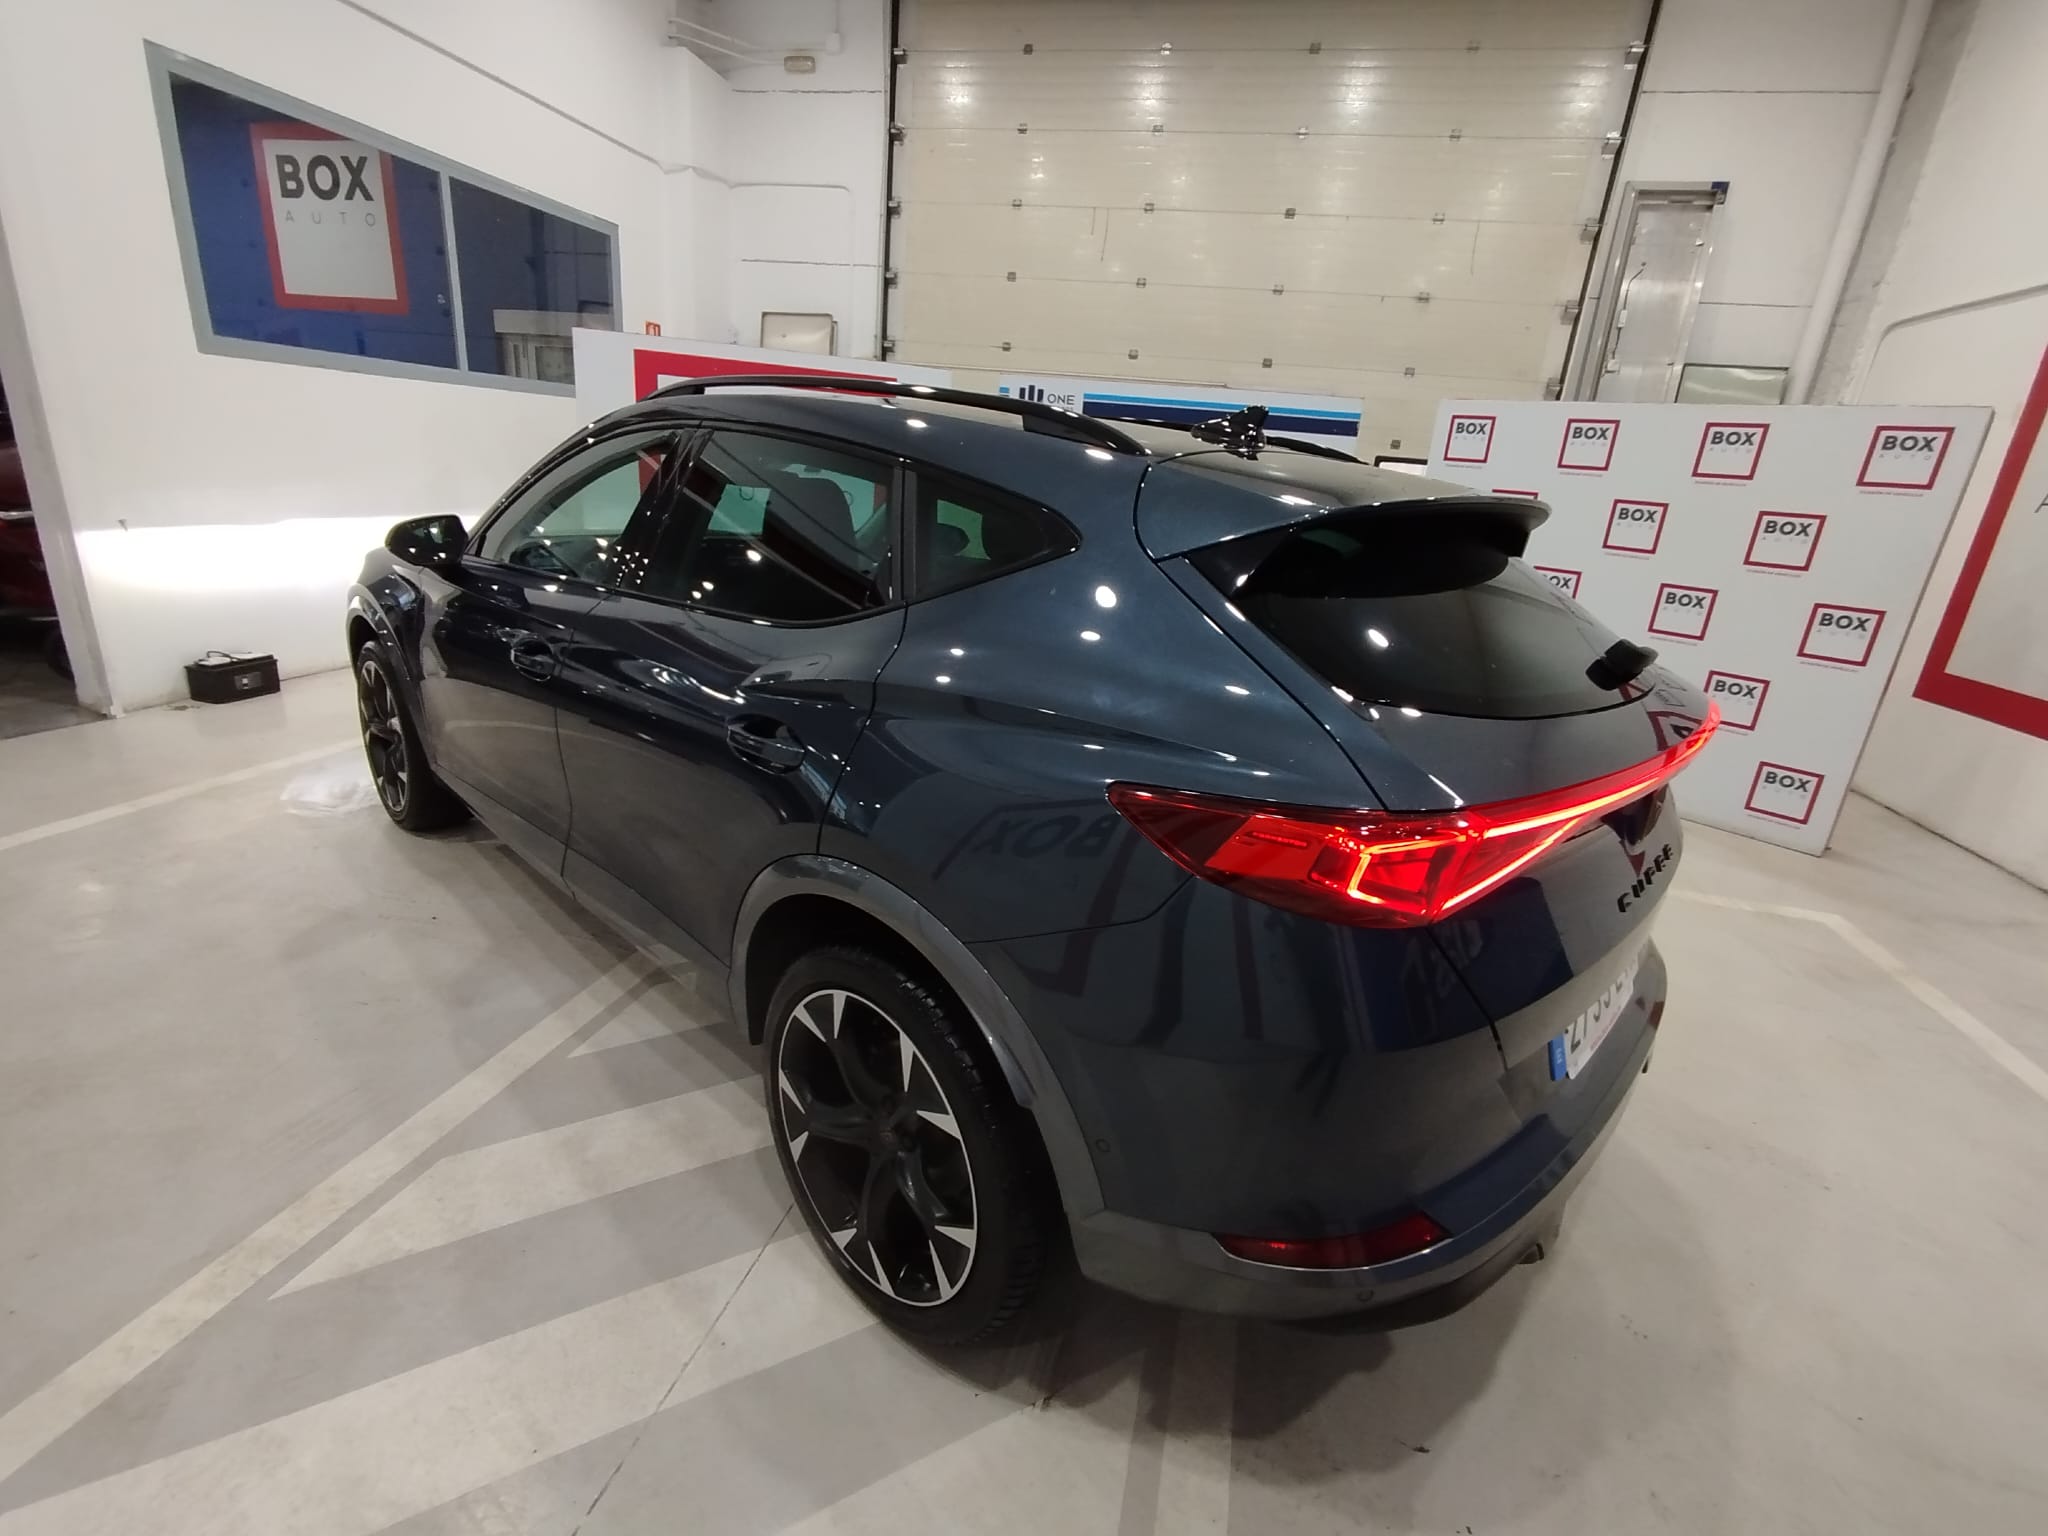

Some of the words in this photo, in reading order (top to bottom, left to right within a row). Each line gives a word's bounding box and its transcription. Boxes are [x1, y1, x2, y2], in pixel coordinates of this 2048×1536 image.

[275, 154, 375, 201] BOX
[285, 209, 377, 227] AUTO
[1047, 393, 1075, 405] ONE
[1455, 422, 1487, 435] BOX
[1572, 426, 1610, 440] BOX
[1710, 431, 1757, 446] BOX
[1881, 435, 1938, 452] BOX
[1618, 507, 1658, 523] BOX
[1763, 520, 1813, 537] BOX
[1664, 592, 1706, 609] BOX
[1819, 613, 1872, 632] BOX
[1713, 680, 1758, 699] BOX
[1764, 771, 1811, 792] BOX
